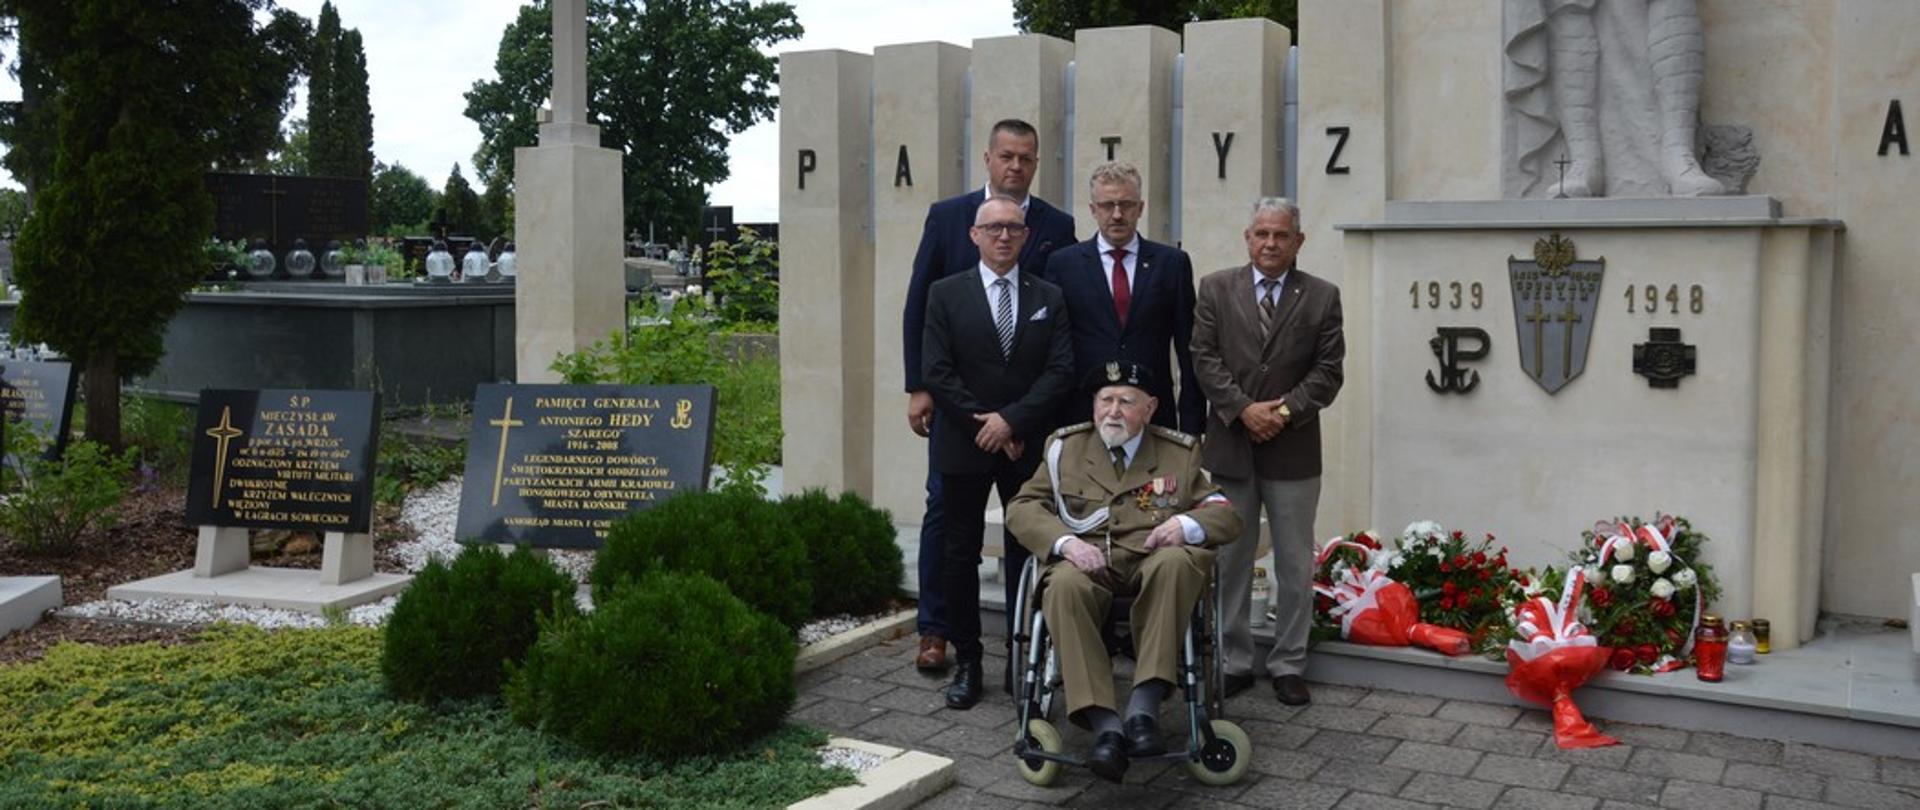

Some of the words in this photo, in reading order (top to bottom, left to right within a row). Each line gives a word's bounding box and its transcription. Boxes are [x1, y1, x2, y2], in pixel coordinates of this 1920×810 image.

[1409, 281, 1484, 309] 1939
[1624, 284, 1704, 313] 1948
[535, 397, 586, 410] PAMIĘCI
[539, 415, 602, 427] ANTONIEGO
[609, 413, 655, 427] HEDY
[265, 423, 330, 436] ZASADA
[232, 458, 292, 469] ODZNACZONY
[524, 454, 604, 465] LEGENDARNEGO
[607, 454, 659, 466] DOWÓDCY
[276, 470, 312, 480] VIRTUTI
[315, 471, 354, 482] MILITARI
[511, 464, 604, 477] ŚWIĘTOKRZYSKICH
[608, 465, 670, 477] ODDZIAŁÓW
[229, 479, 288, 489] DWUKROTNIE
[503, 477, 584, 487] PARTYZANCKICH
[587, 478, 617, 488] ARMII
[621, 479, 675, 490] KRAJOWEJ
[290, 491, 352, 502] WALECZNYCH
[519, 488, 591, 499] HONOROWEGO
[594, 490, 655, 501] OBYWATELA
[543, 499, 579, 509] MIASTA
[582, 499, 628, 510] KOŃSKIE
[233, 511, 242, 519] W
[291, 513, 350, 523] SOWIECKICH
[552, 518, 584, 528] MIASTA
